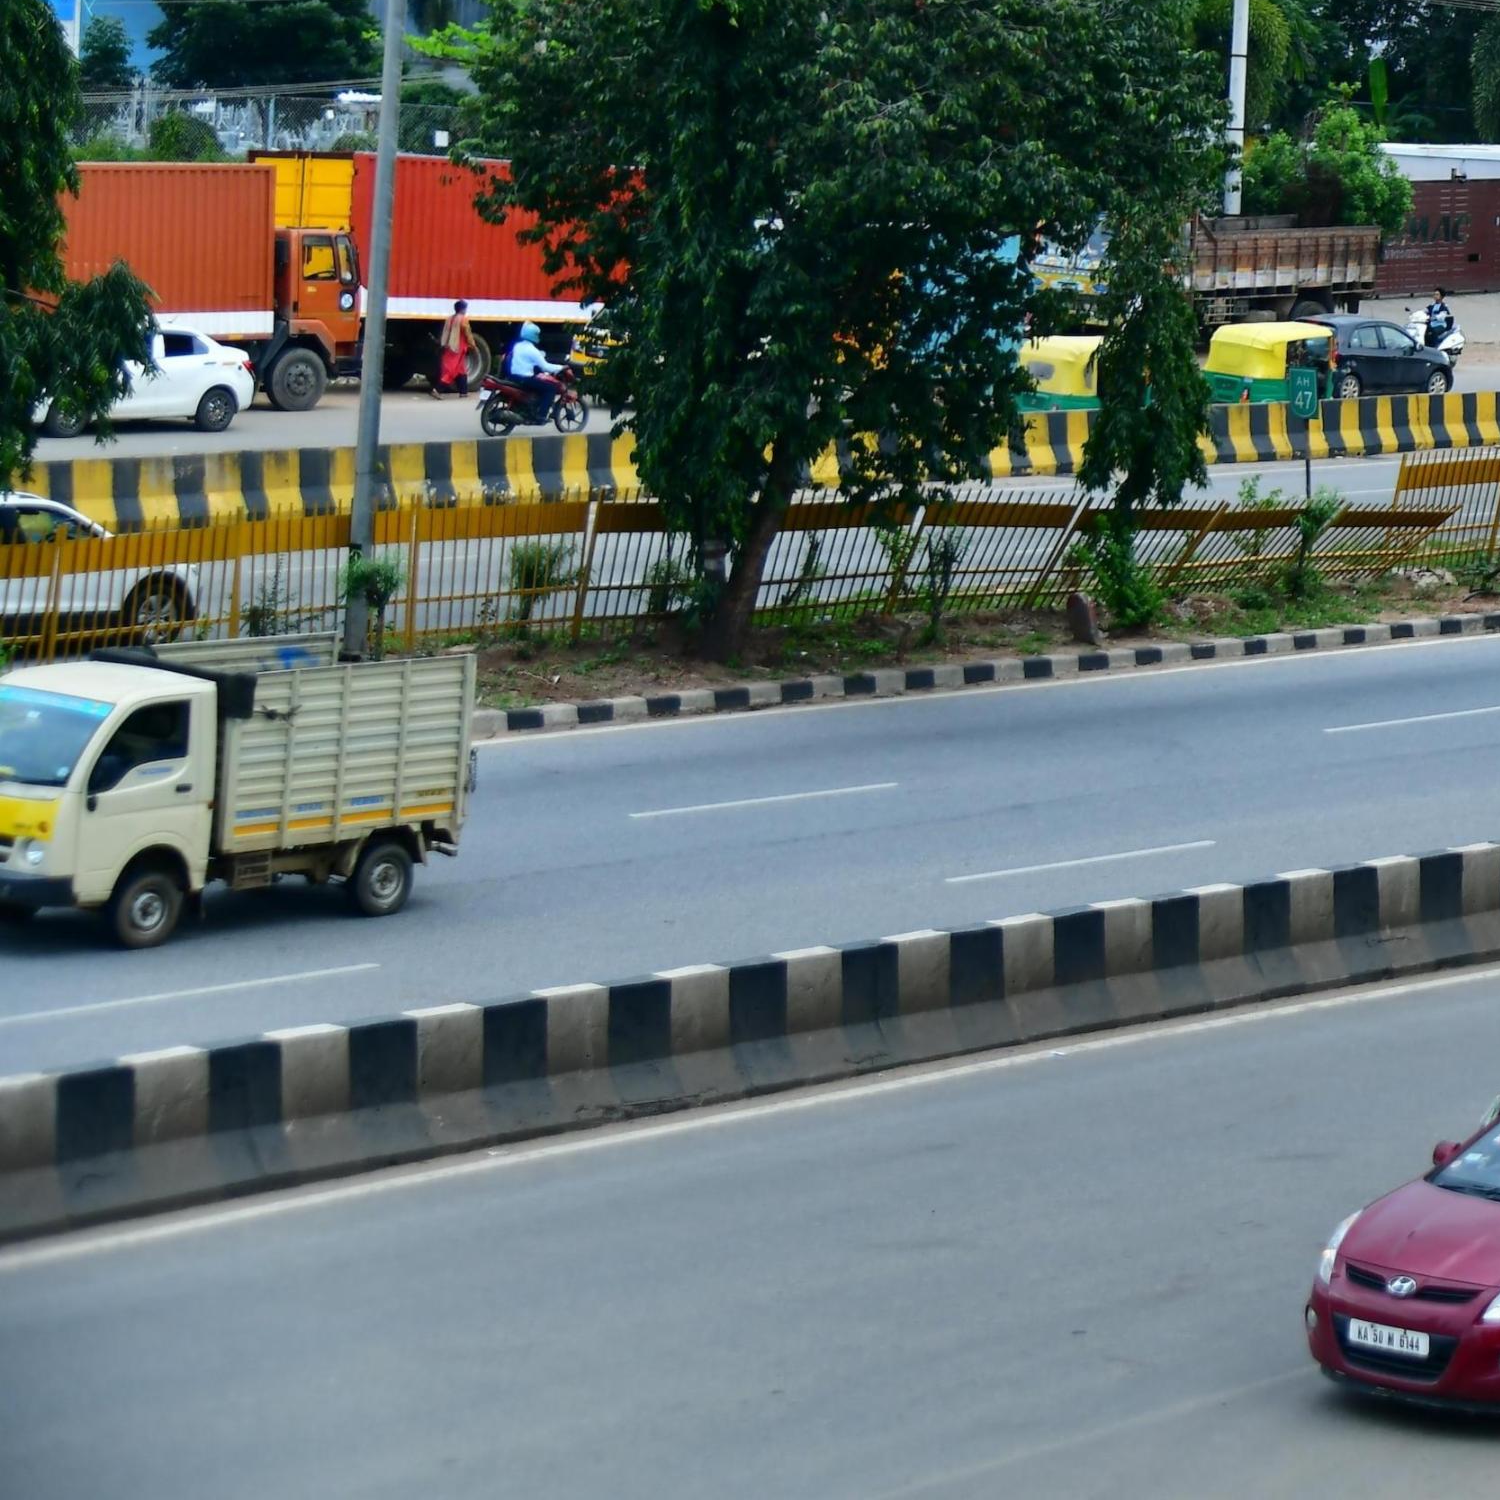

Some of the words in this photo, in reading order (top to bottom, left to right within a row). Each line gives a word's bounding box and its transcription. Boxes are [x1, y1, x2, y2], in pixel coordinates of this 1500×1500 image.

[1296, 376, 1310, 387] AH
[1295, 391, 1313, 409] 47
[1358, 1325, 1369, 1341] KA
[1373, 1328, 1384, 1344] 50
[1400, 1334, 1420, 1352] 6144
